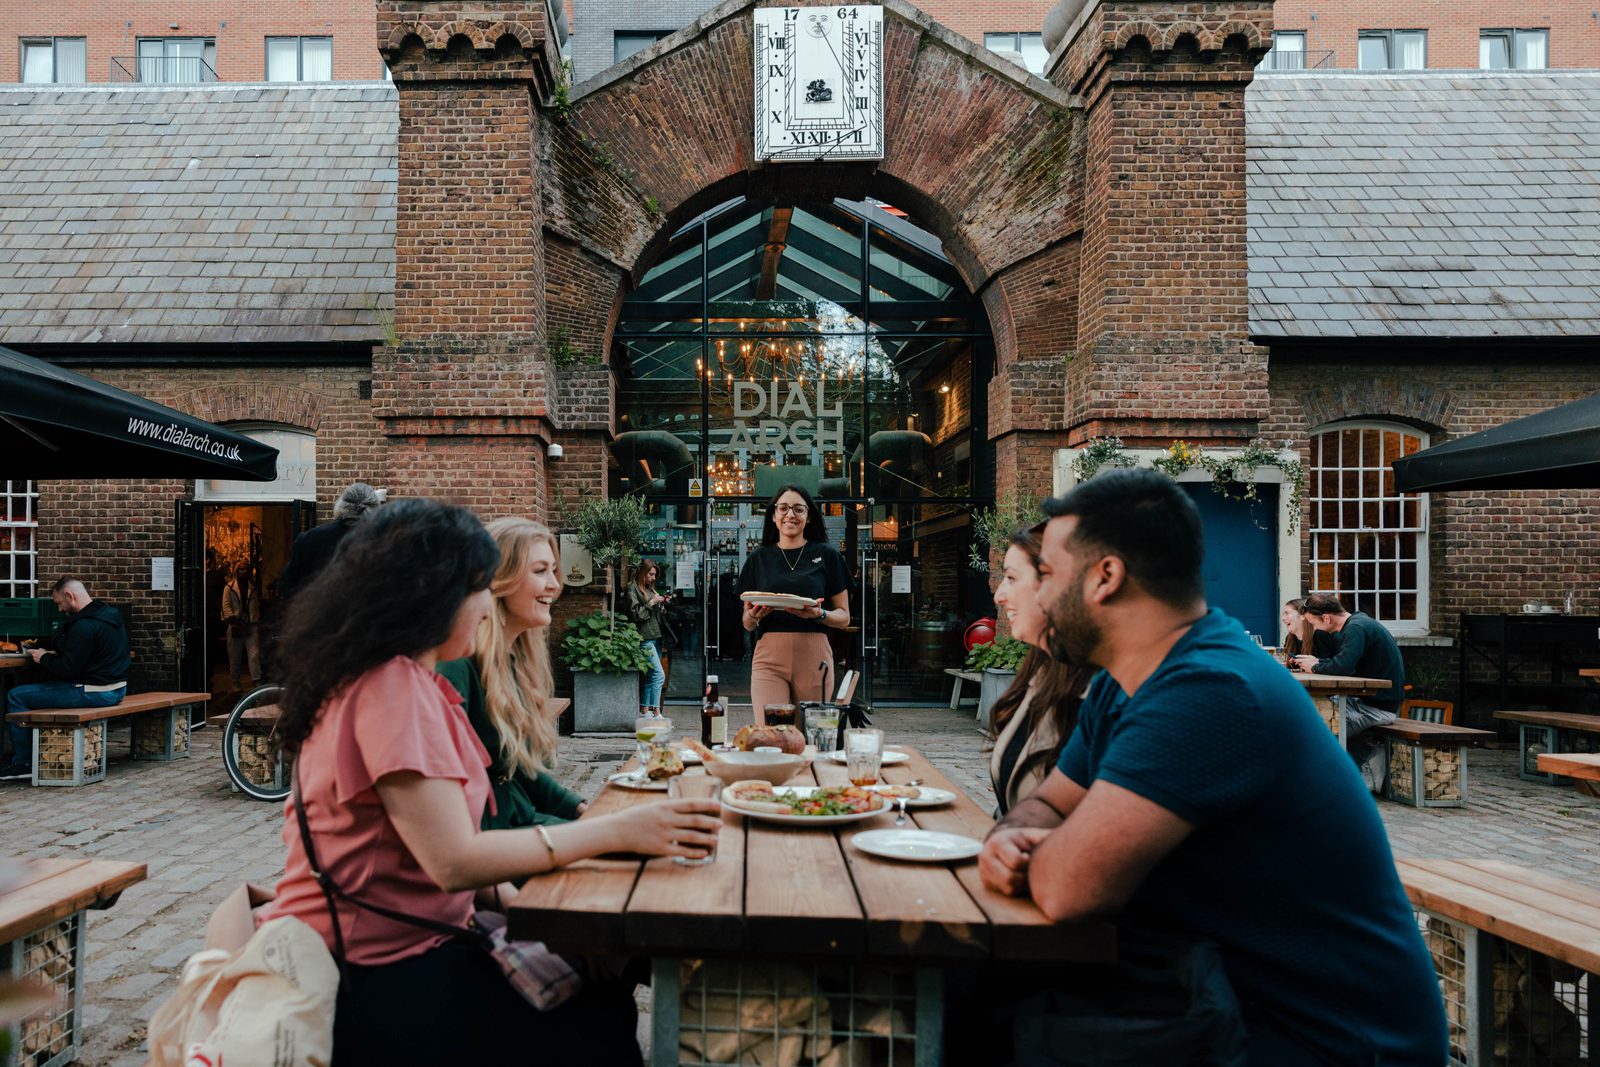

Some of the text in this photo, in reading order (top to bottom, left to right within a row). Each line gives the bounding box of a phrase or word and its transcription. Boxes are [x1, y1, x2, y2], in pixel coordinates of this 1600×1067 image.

[784, 8, 858, 21] 17 64
[768, 37, 785, 49] VIII
[854, 32, 869, 45] VI
[857, 50, 866, 61] V
[769, 64, 784, 77] IX
[855, 69, 868, 82] IV
[855, 97, 868, 109] III
[771, 111, 782, 123] X
[791, 132, 805, 144] XI
[809, 132, 828, 144] XII
[853, 131, 862, 143] II
[734, 381, 843, 418] DIAL
[127, 417, 243, 461] www.dialarch.co.uk
[725, 420, 844, 455] ARCH
